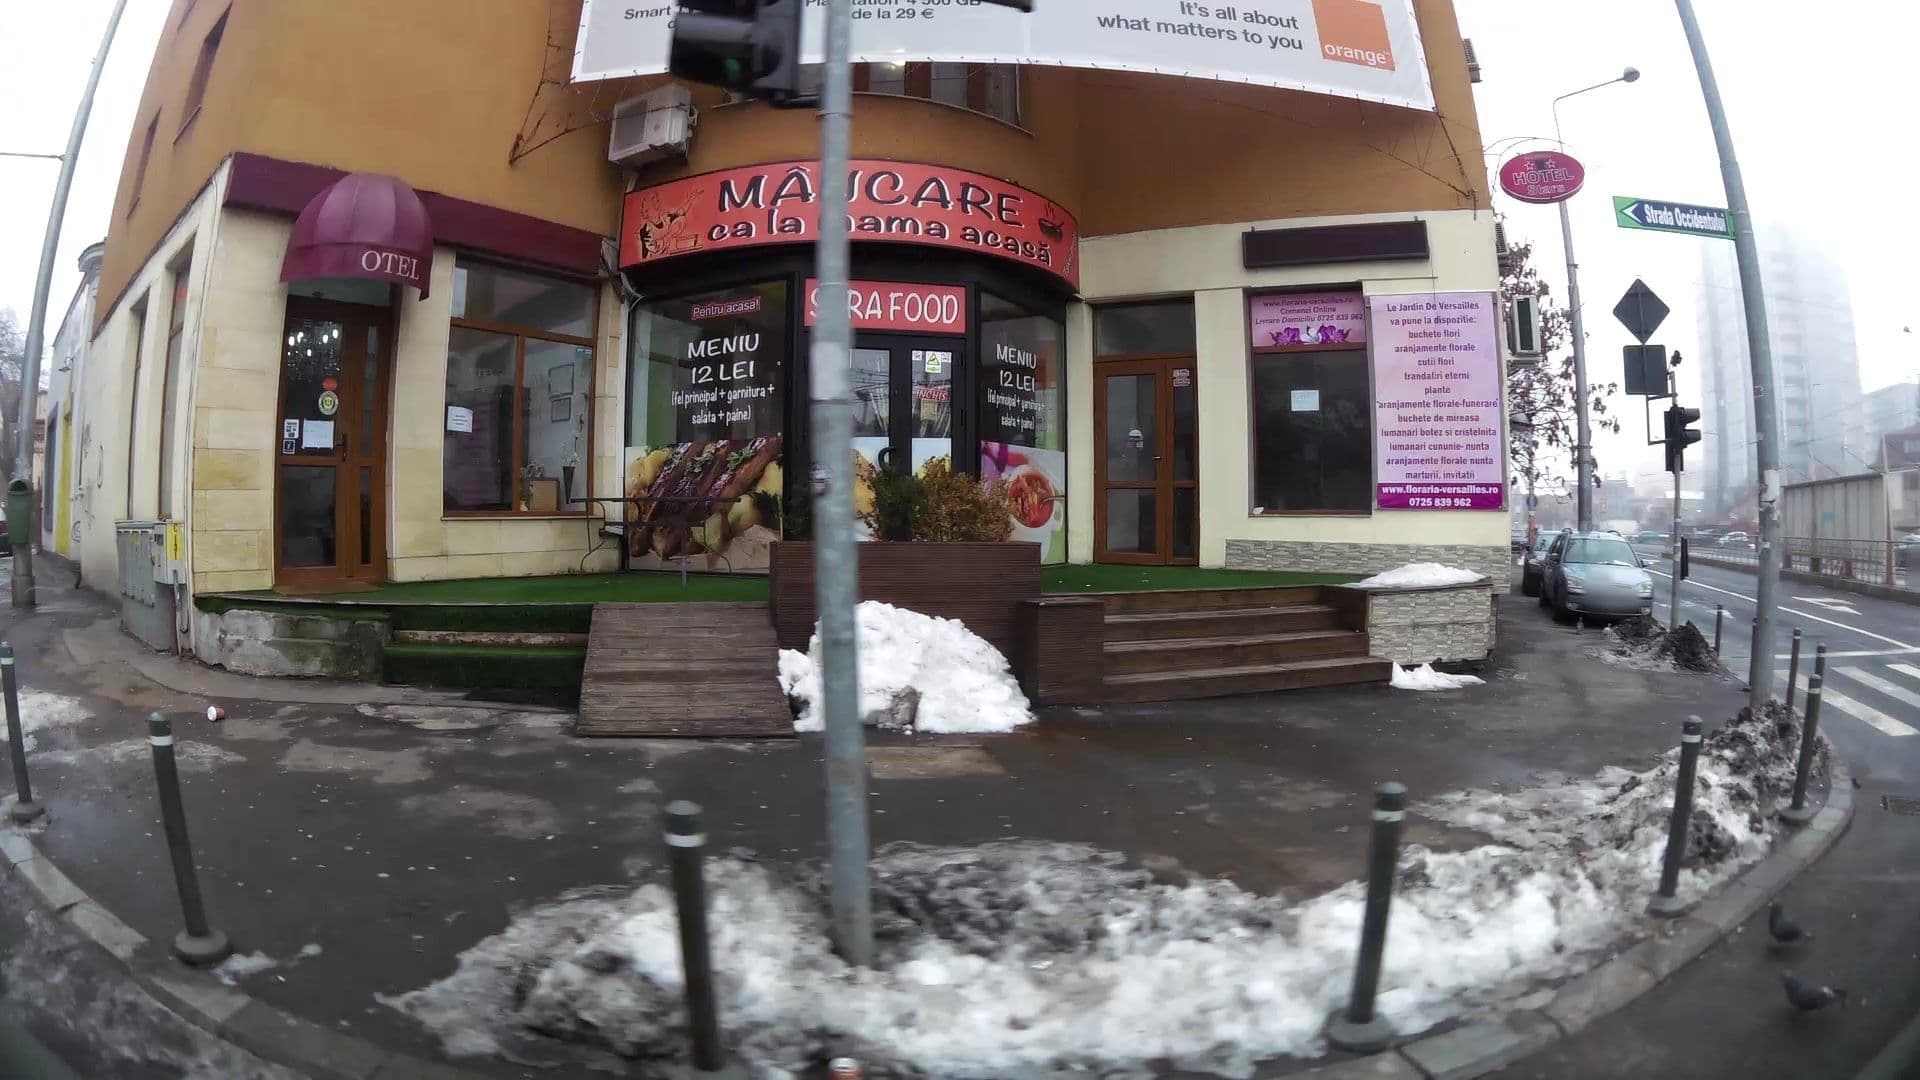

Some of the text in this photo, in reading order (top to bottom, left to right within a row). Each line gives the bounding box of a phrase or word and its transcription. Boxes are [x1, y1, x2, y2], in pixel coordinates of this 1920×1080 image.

[624, 5, 671, 20] Smart
[851, 8, 935, 19] de la 29 €
[1179, 1, 1300, 30] It's all about
[1097, 15, 1303, 51] what matters to you
[1324, 43, 1387, 65] orange
[1512, 167, 1574, 186] HOTEL
[1644, 204, 1727, 232] Strada Occidentului
[707, 220, 756, 242] ca
[768, 208, 805, 235] la
[960, 226, 1052, 267] acasă
[361, 250, 420, 281] OTEL
[692, 298, 759, 318] Pentru acasa!
[810, 287, 959, 324] SRA FOOD
[1313, 306, 1336, 314] Online
[1387, 301, 1480, 312] Le Jardin De Versailles
[1390, 318, 1400, 326] va
[1401, 318, 1422, 327] pune
[1424, 316, 1432, 325] la
[1408, 329, 1461, 339] buchete flori
[687, 333, 760, 359] MENIU
[1394, 343, 1476, 354] aranjamente florale
[996, 343, 1037, 370] MENIU
[1417, 356, 1455, 366] cutii flori
[691, 360, 755, 385] 12 LEI
[1404, 371, 1470, 381] trandafiri eterni
[1000, 369, 1035, 393] 12 LEI
[685, 387, 718, 409] principal
[727, 385, 766, 404] garnitura
[1424, 386, 1451, 395] plante
[691, 409, 717, 425] salata
[1397, 413, 1480, 423] buchete de mireasa
[1381, 427, 1497, 437] lumanari botez si cristelnita
[1389, 442, 1426, 451] lumanari
[1465, 442, 1490, 451] nunta
[1386, 456, 1494, 467] aranjamente florale nunta
[1443, 470, 1475, 480] invitatii
[1409, 497, 1472, 507] 0725 839 962
